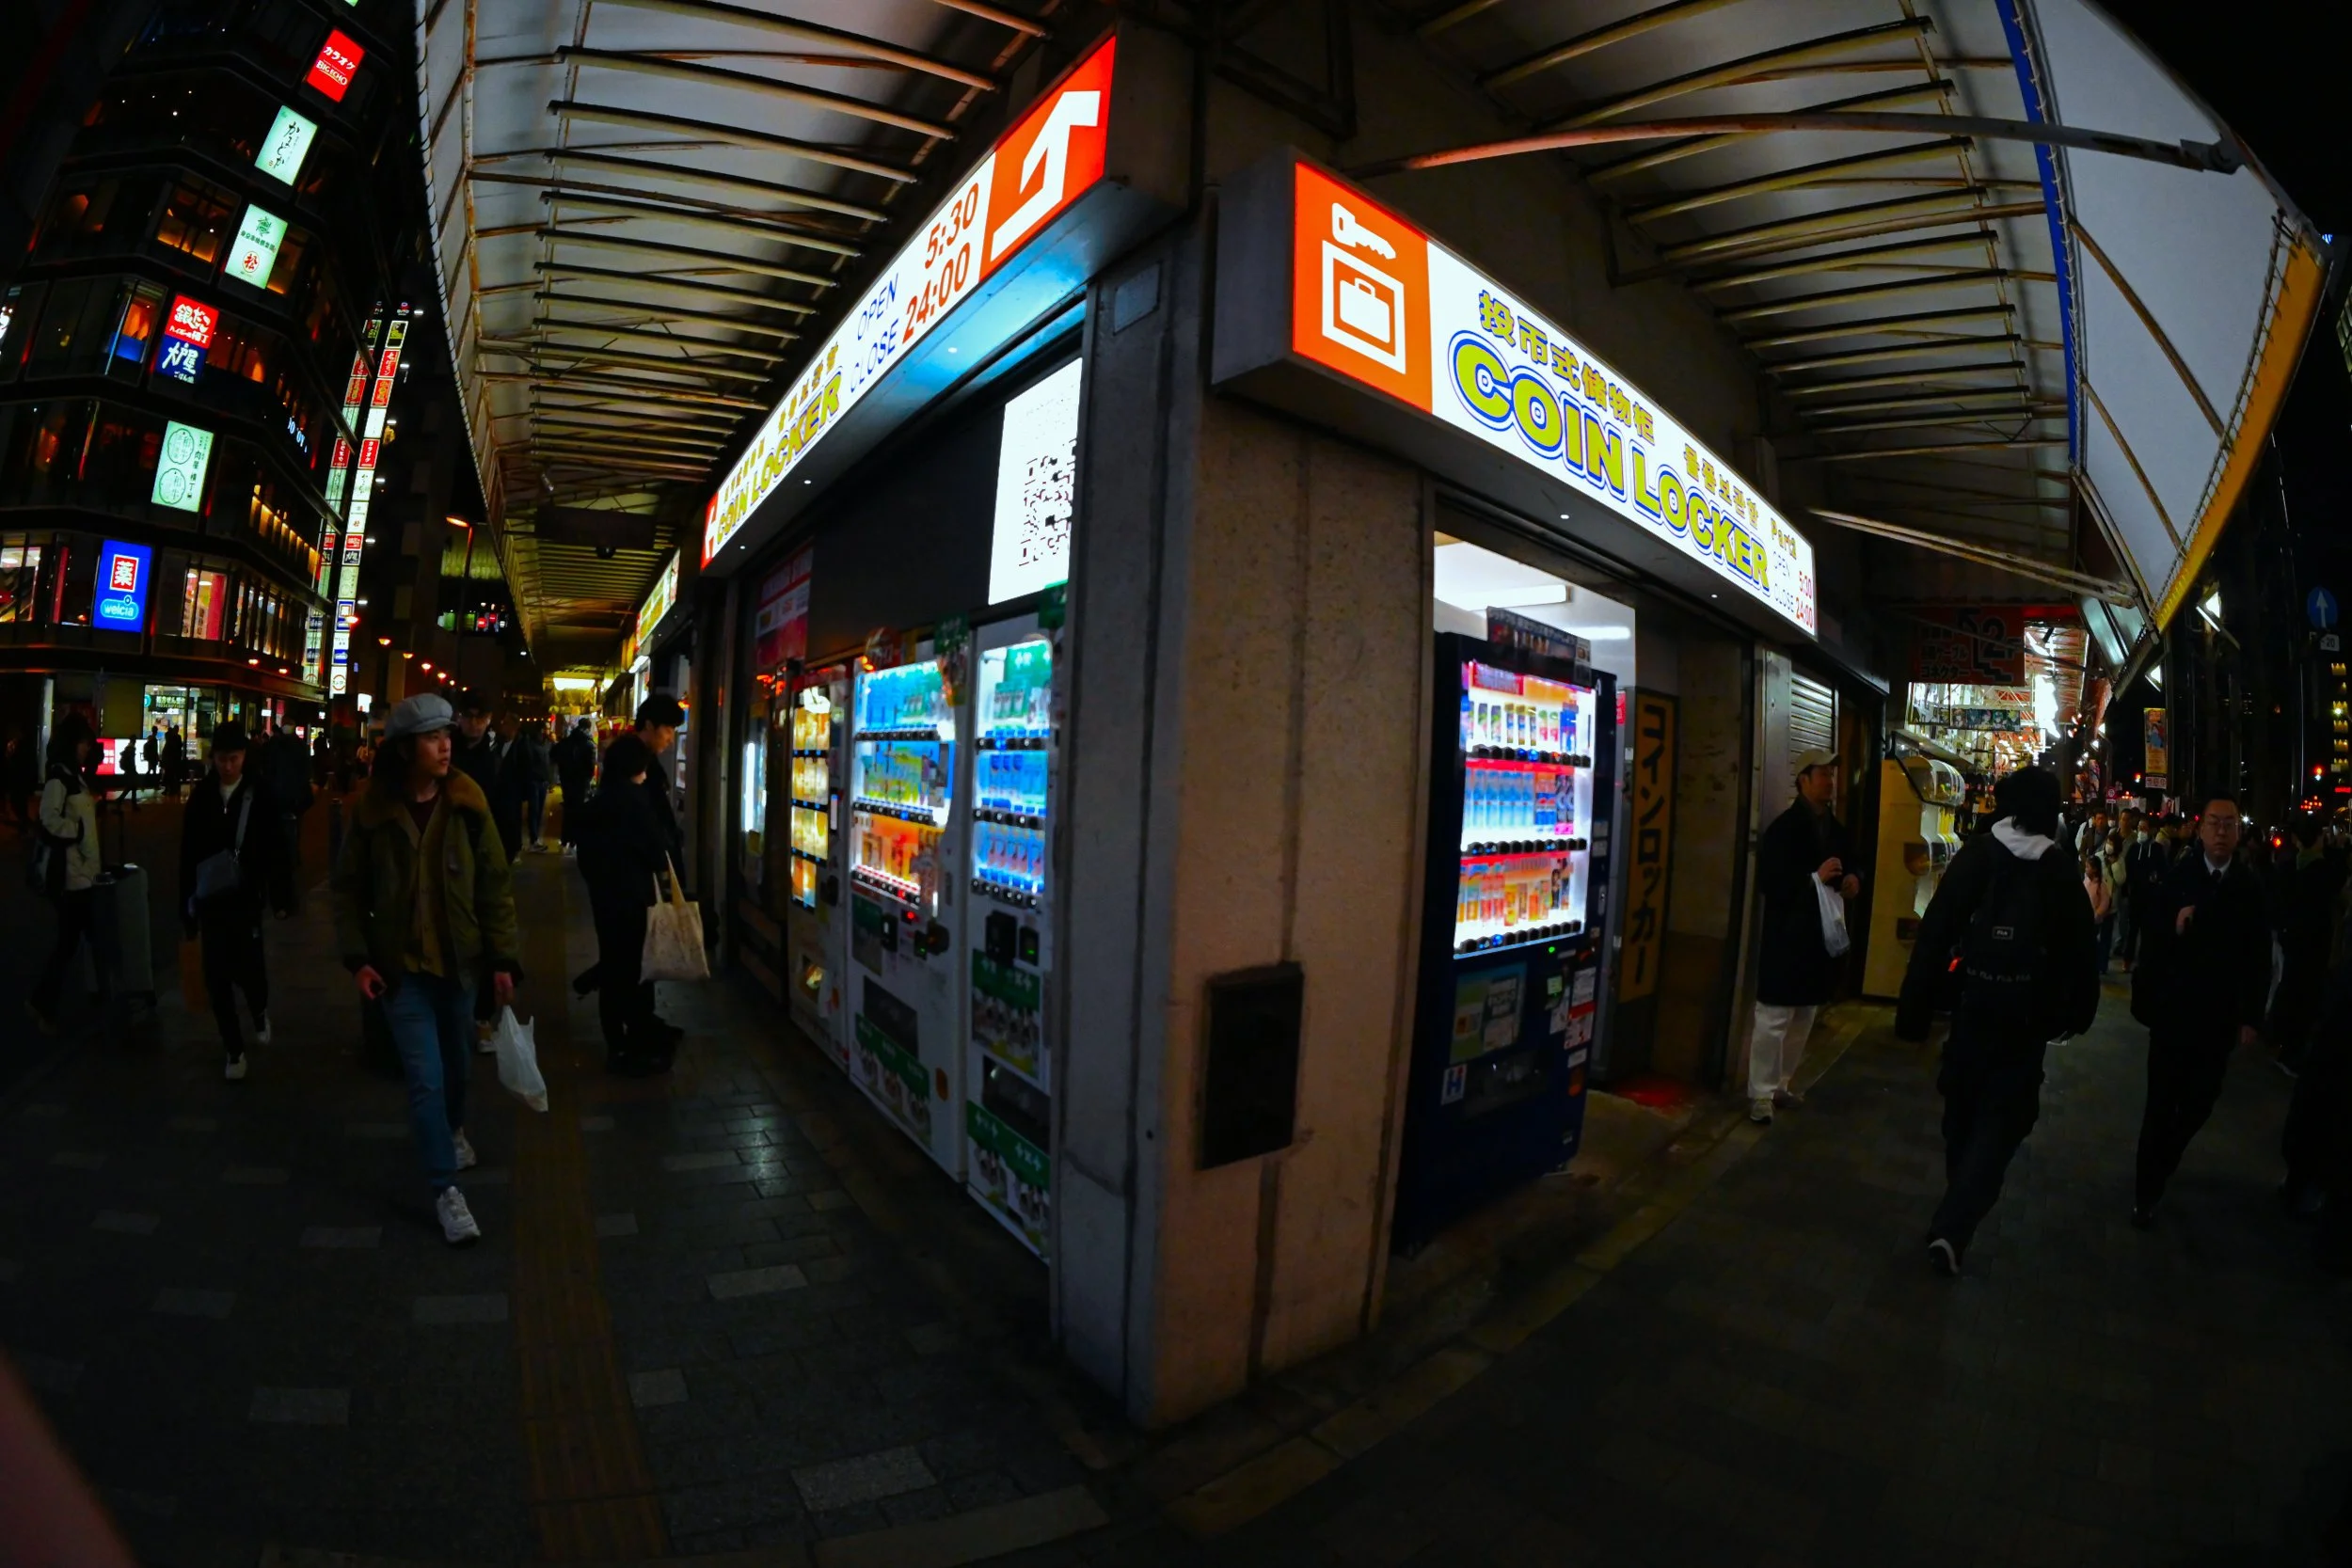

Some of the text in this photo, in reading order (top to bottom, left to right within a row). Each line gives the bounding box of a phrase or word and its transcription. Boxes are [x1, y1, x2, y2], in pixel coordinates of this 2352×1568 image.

[316, 59, 329, 73] BIG
[329, 66, 348, 86] ECHO
[324, 46, 356, 71] カラオケ
[924, 182, 979, 270] 5:30
[857, 272, 899, 341] OPEN
[902, 241, 971, 345] 24:00
[161, 341, 199, 375] 大戸屋
[850, 317, 899, 393] CLOSE
[1478, 290, 1656, 447] 投币式储物柜
[717, 481, 750, 546] COIN
[750, 370, 843, 508] LOCKER
[1450, 334, 1771, 594] COIN LOCKER
[114, 560, 133, 587] 薬
[1773, 581, 1795, 613] CLOSE
[103, 601, 135, 618] welcia
[1794, 595, 1815, 629] 24:00
[1921, 664, 1970, 681] コネクター
[1630, 704, 1666, 986] コインロッカー
